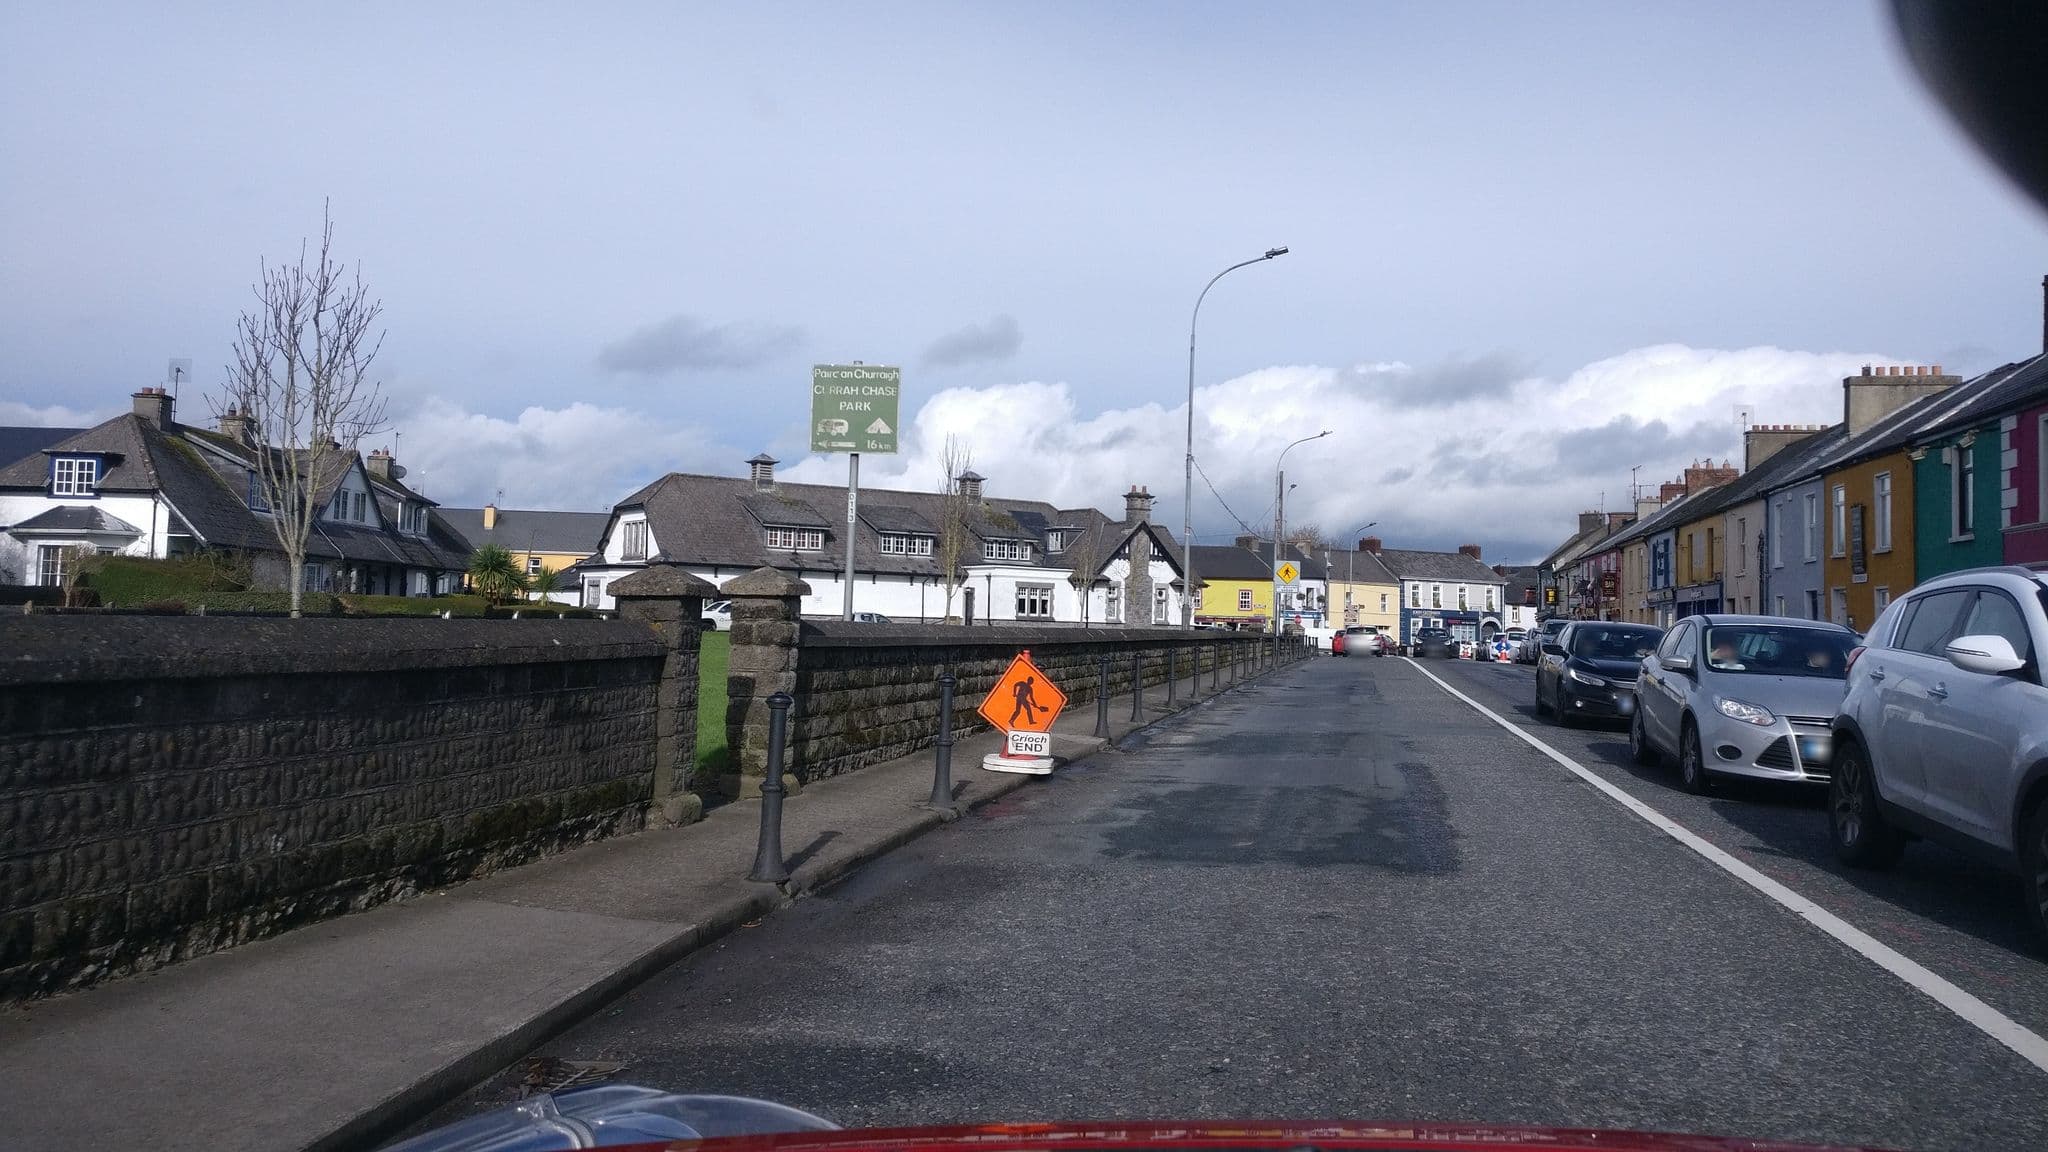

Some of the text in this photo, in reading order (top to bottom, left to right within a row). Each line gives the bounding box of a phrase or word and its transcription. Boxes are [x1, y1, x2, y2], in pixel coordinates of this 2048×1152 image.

[840, 370, 853, 379] an
[853, 368, 899, 381] Churraigh
[814, 385, 897, 397] CRRAH CHASE
[839, 401, 871, 411] PARK
[867, 440, 877, 449] 16
[1015, 743, 1043, 753] END
